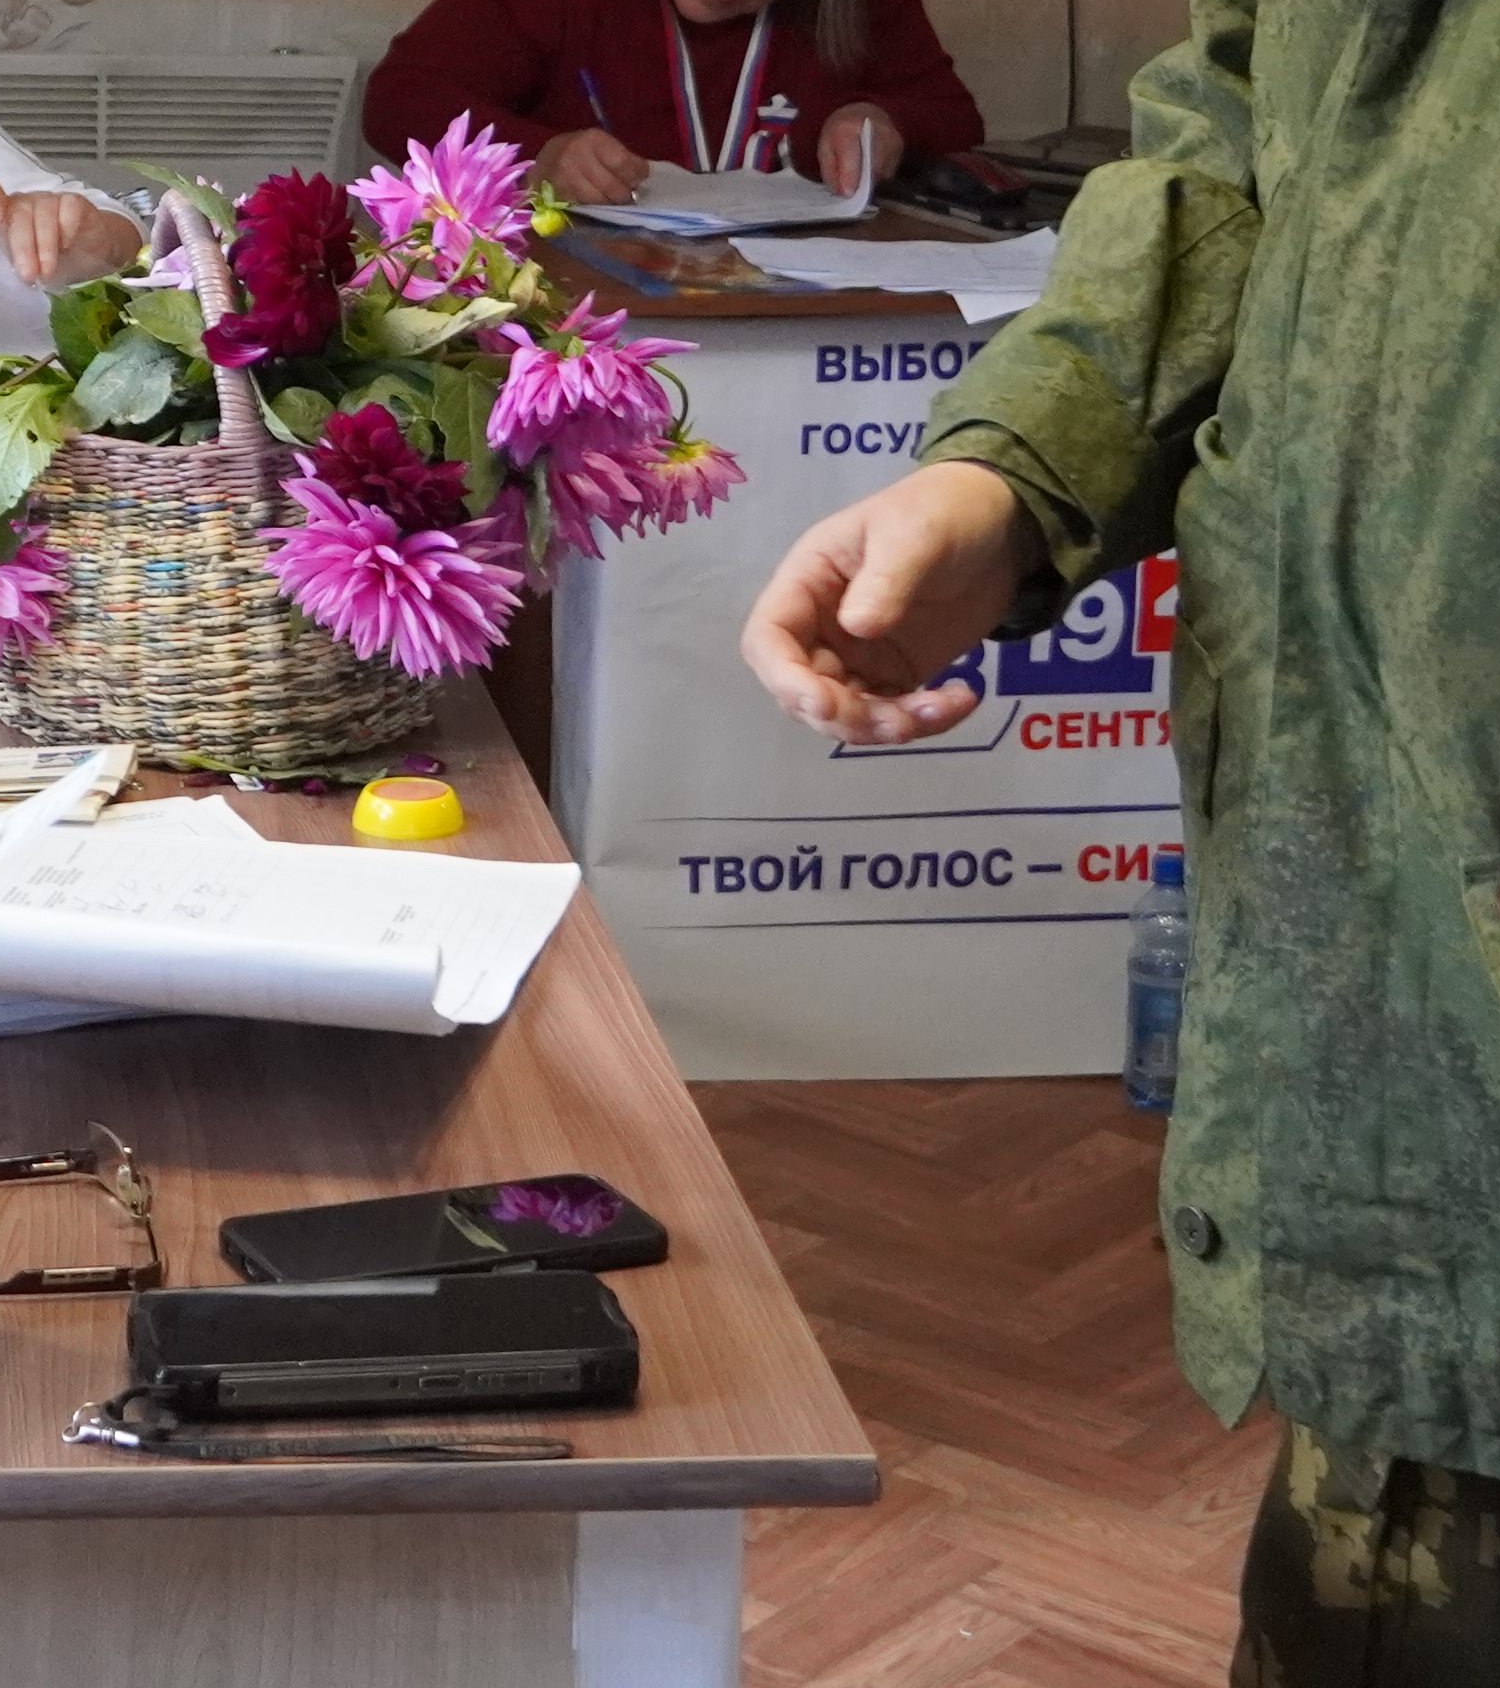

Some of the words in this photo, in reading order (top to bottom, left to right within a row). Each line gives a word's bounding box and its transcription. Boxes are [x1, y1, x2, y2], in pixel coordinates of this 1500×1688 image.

[678, 845, 824, 894] ТВОЙ
[840, 848, 1014, 890] ГОЛОС
[1076, 843, 1185, 883] СИ
